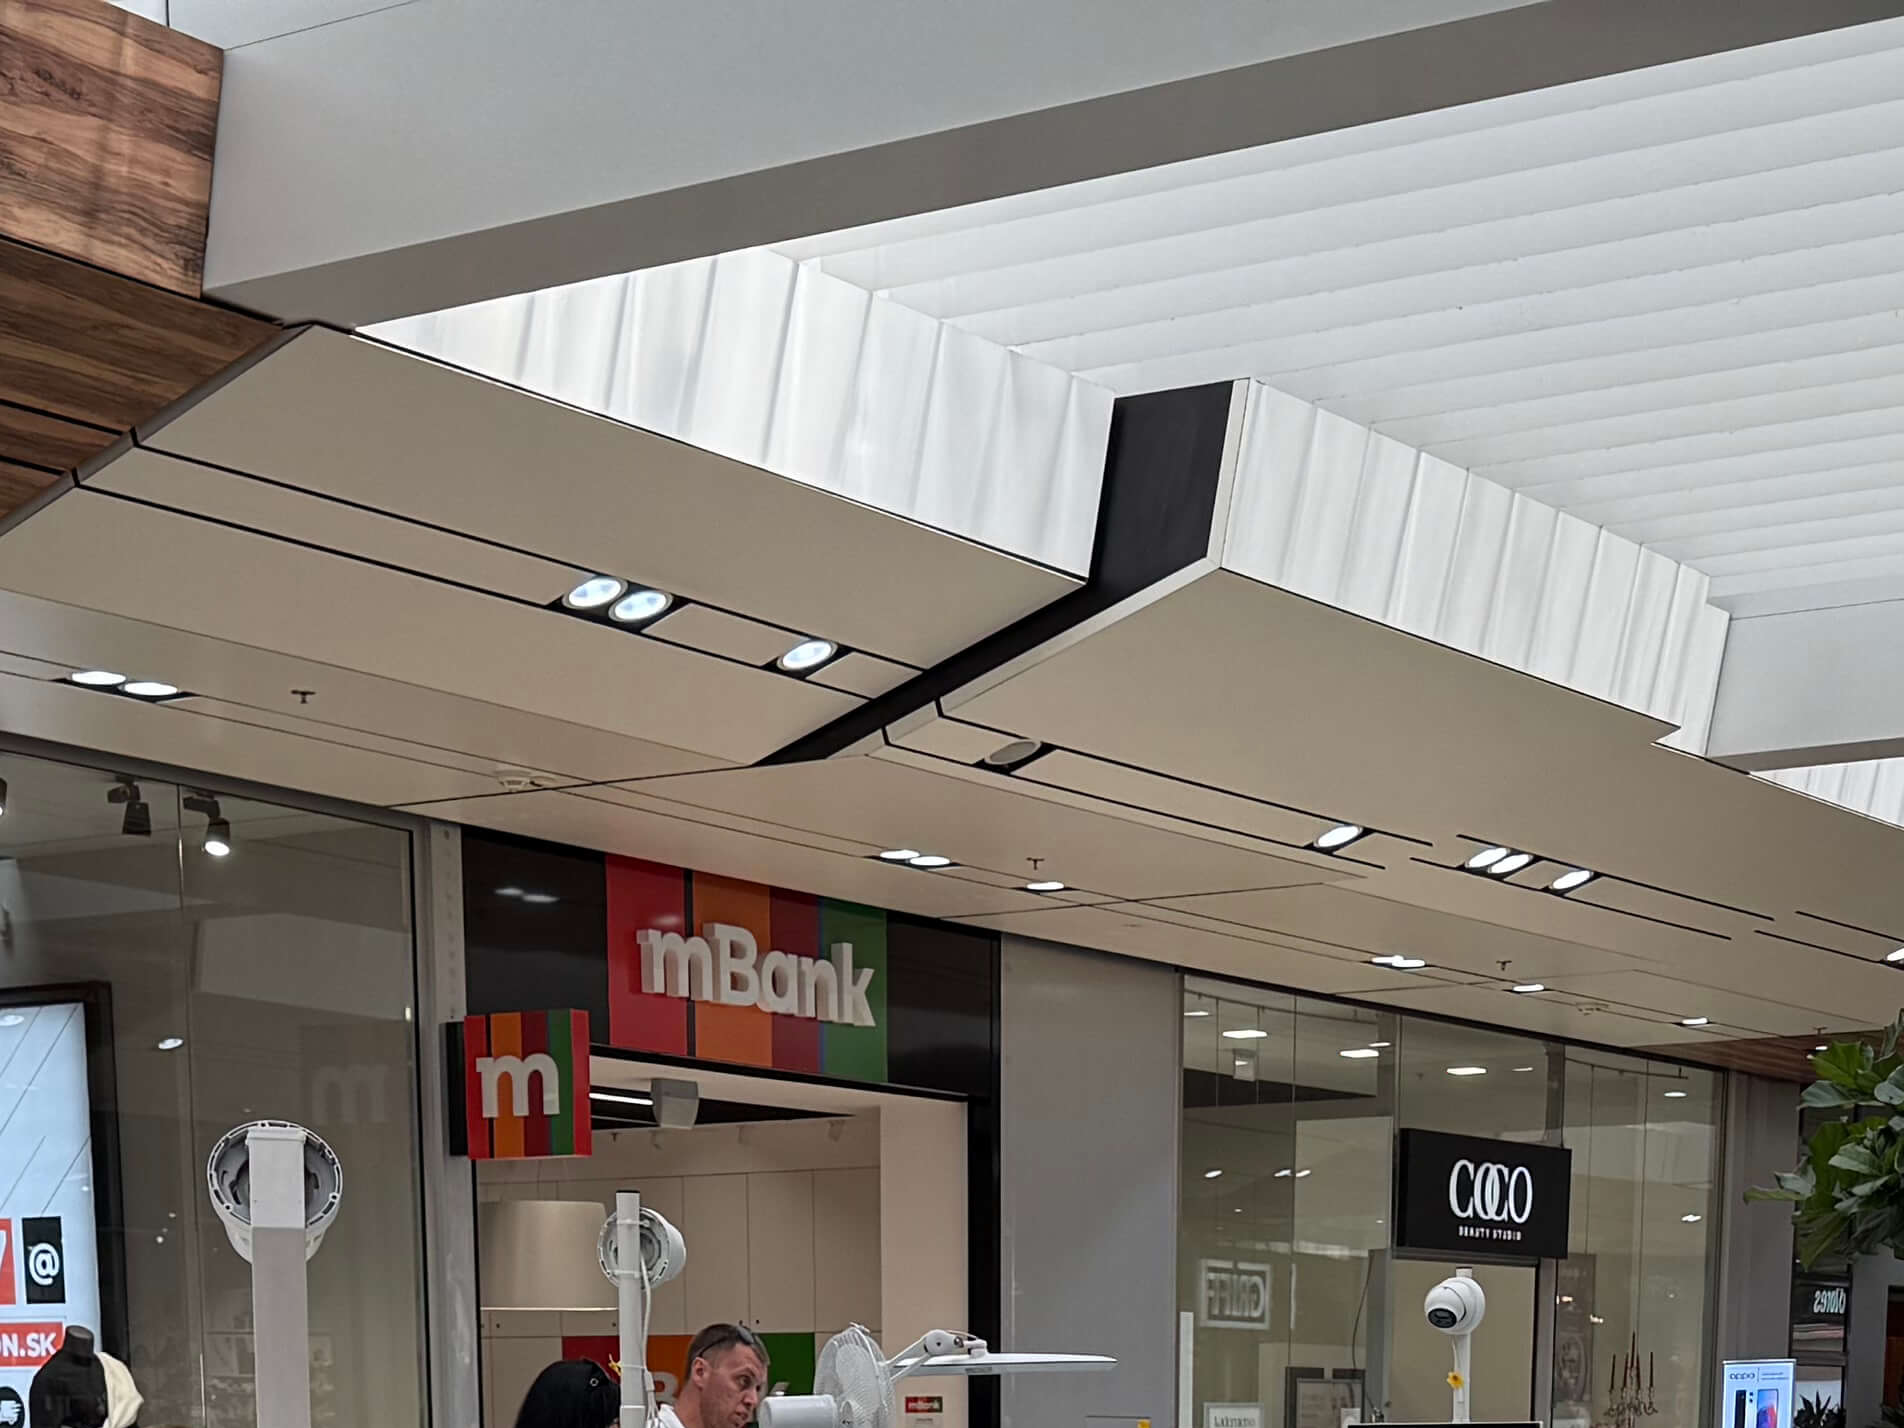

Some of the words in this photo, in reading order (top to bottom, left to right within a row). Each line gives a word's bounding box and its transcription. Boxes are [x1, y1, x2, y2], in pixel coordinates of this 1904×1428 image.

[636, 923, 876, 1027] mBank
[476, 1051, 560, 1119] m
[1449, 1159, 1533, 1223] COCO
[28, 1245, 60, 1285] @
